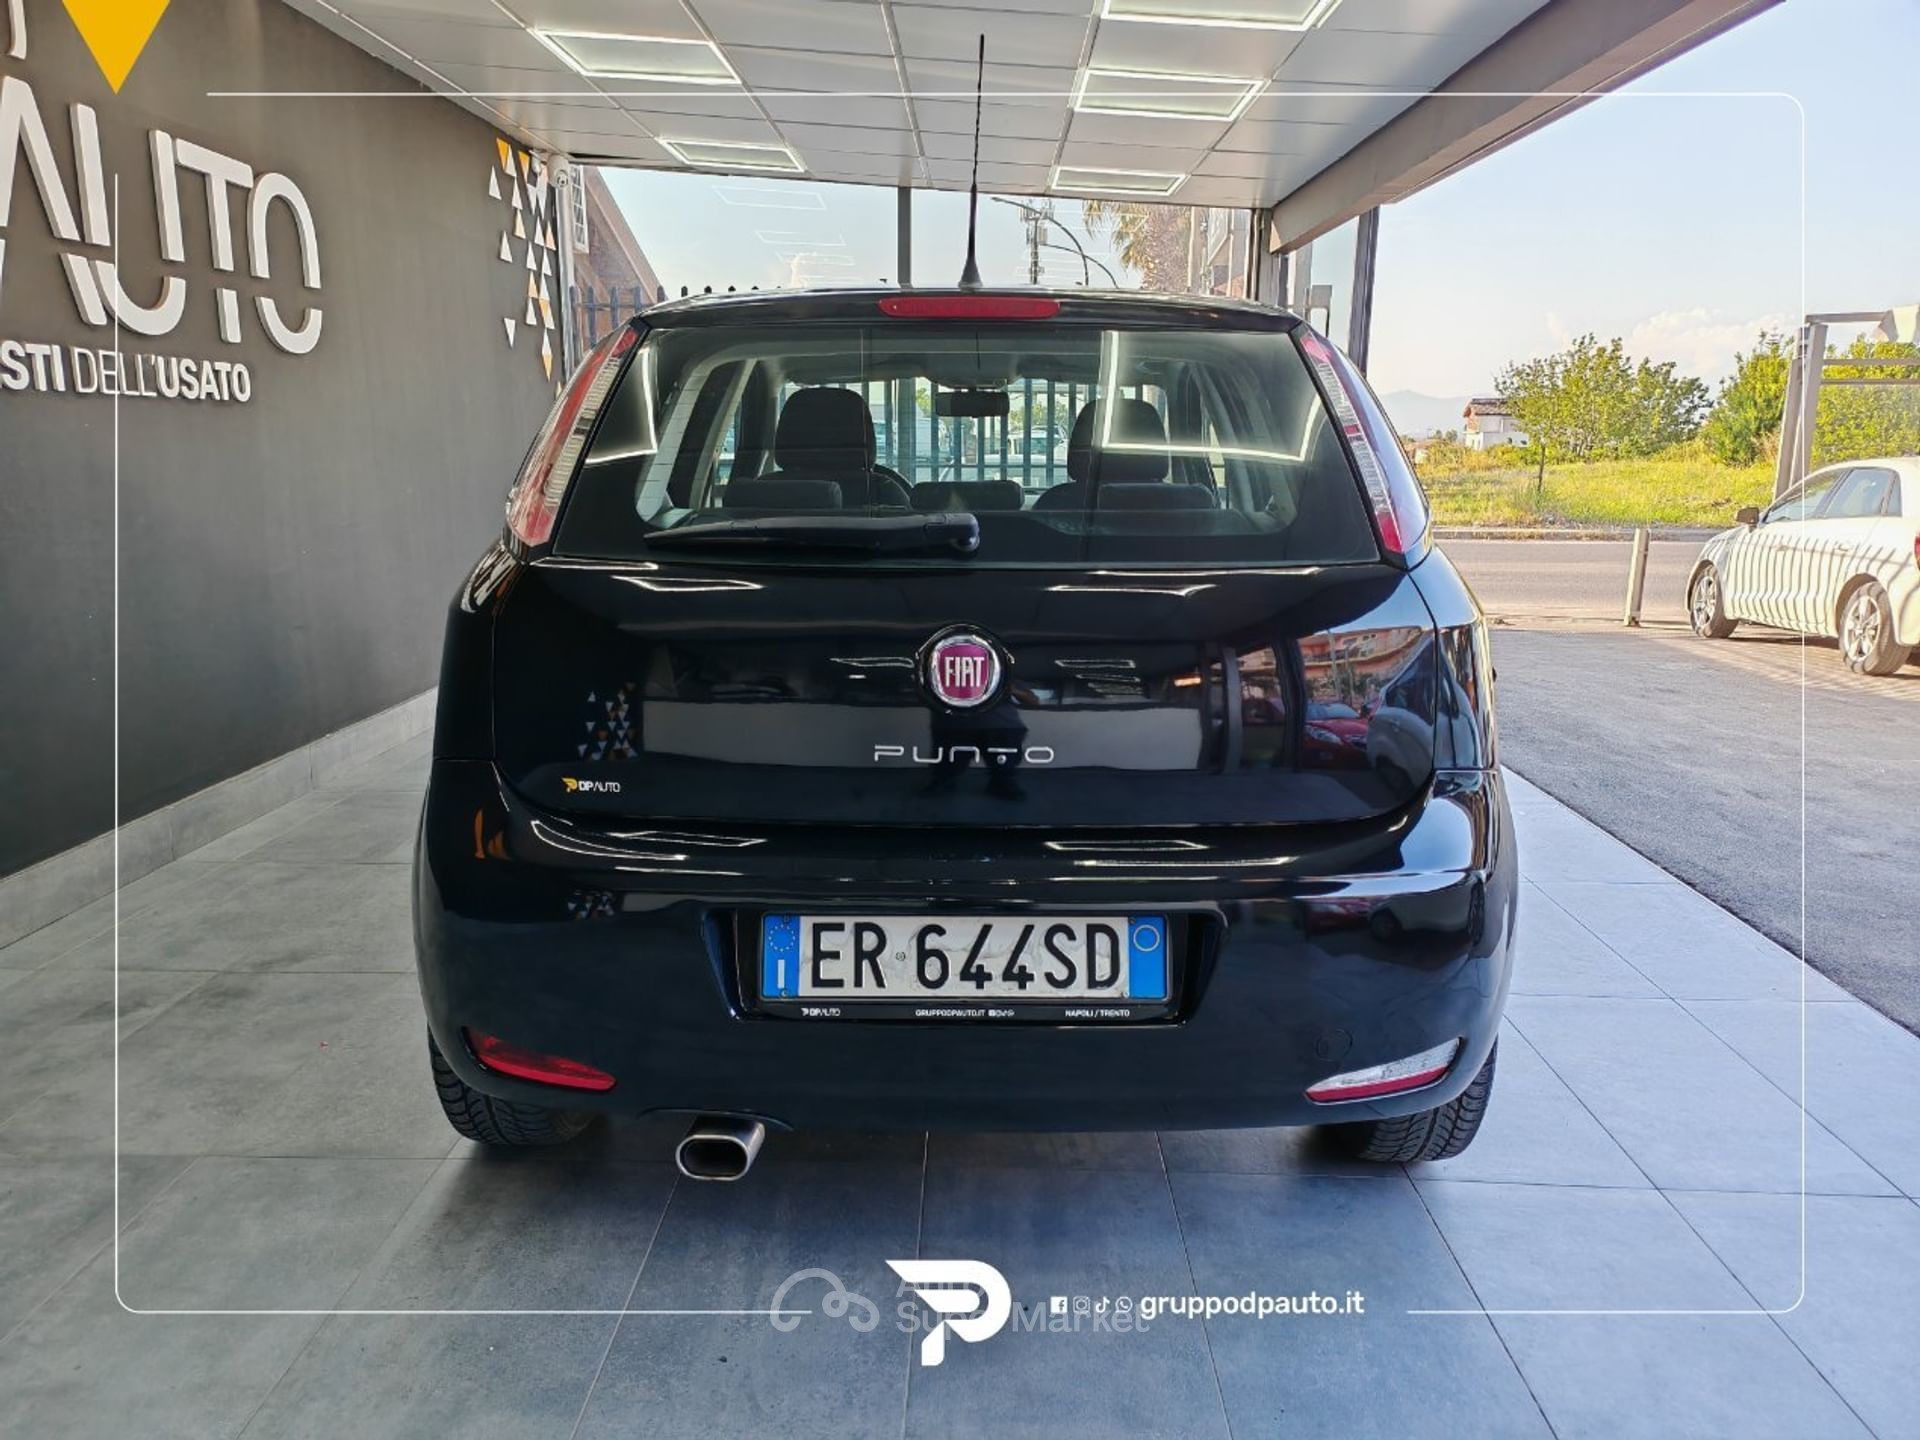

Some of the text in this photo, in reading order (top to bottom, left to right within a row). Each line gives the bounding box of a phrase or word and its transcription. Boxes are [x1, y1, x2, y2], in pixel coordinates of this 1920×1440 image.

[0, 340, 251, 402] STI DELL'USATO
[944, 656, 985, 688] FIAT
[873, 745, 1055, 764] PUNTO
[811, 922, 887, 988] ER
[915, 922, 1121, 990] 644SD
